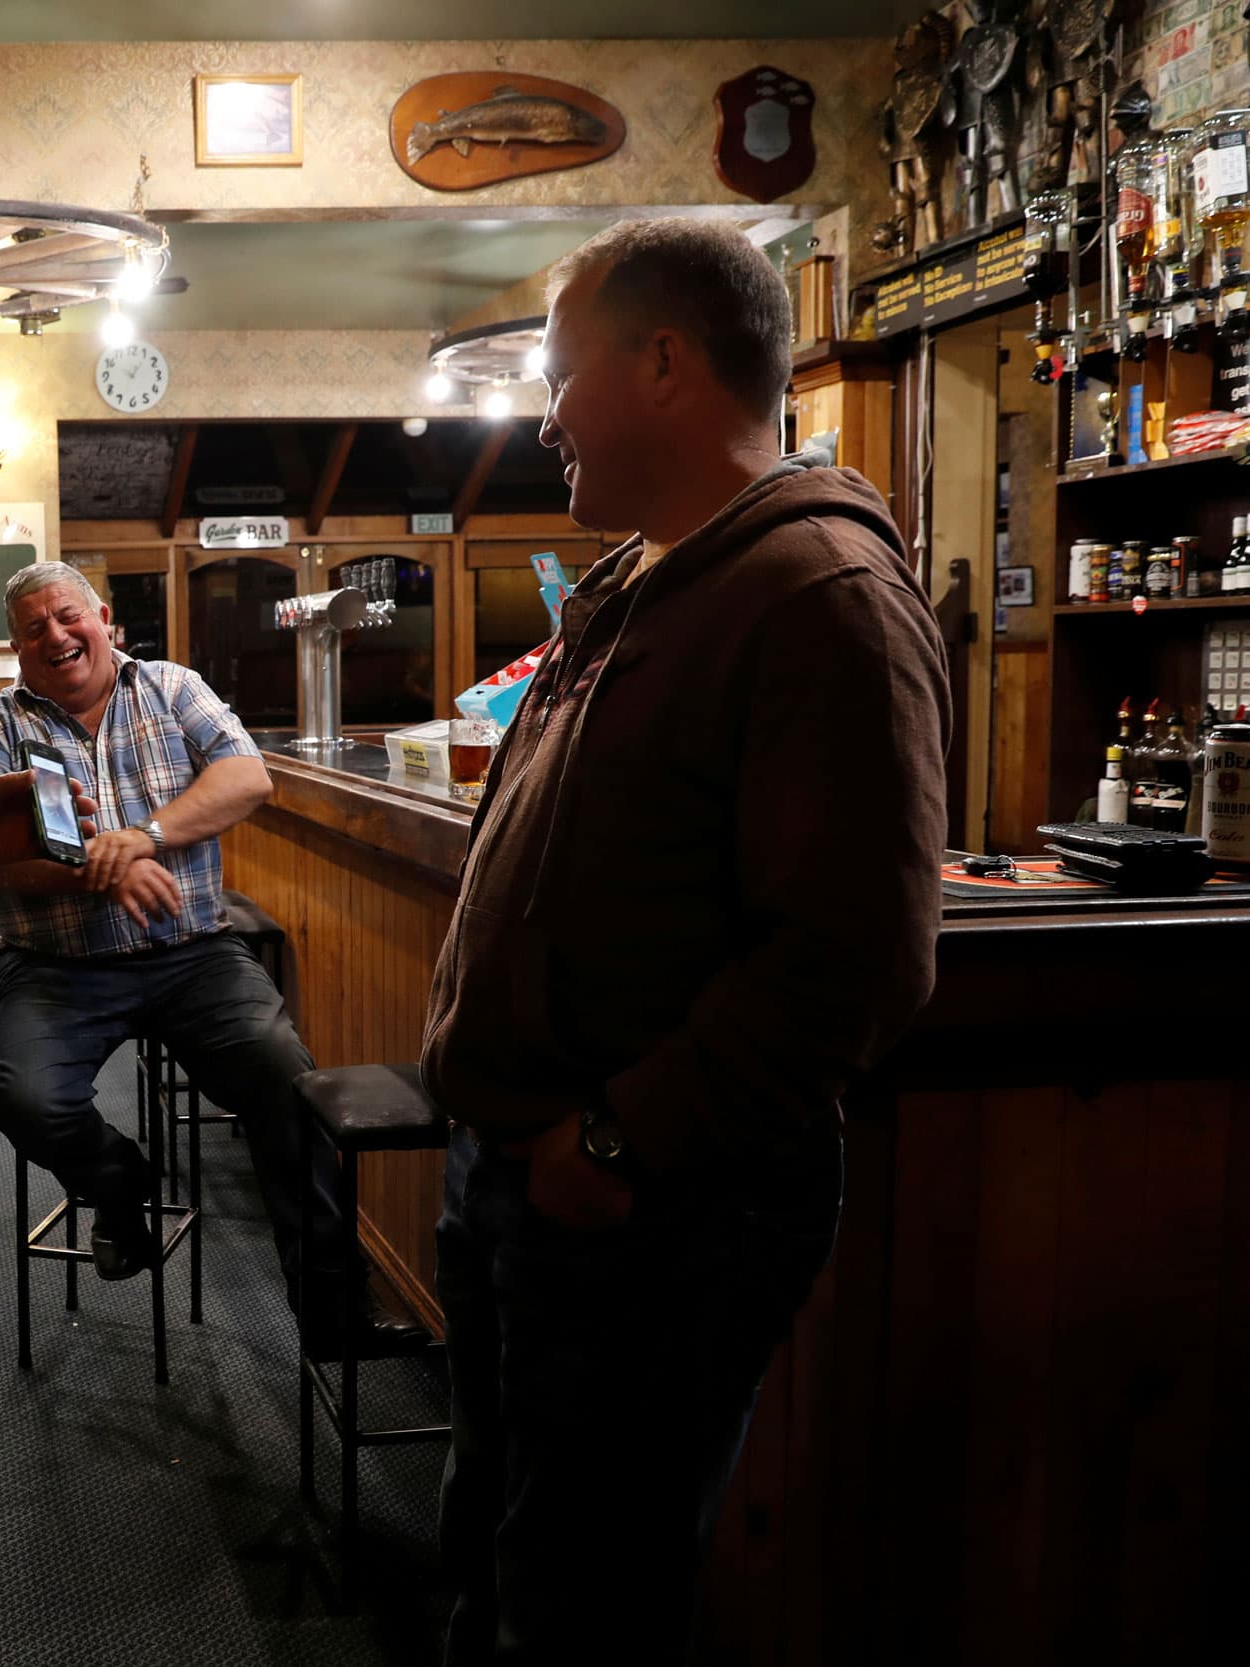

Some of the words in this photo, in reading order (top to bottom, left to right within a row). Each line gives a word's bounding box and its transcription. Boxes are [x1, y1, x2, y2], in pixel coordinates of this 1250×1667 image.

[142, 348, 147, 359] 1
[150, 356, 158, 368] 2
[102, 371, 110, 383] 9
[156, 370, 162, 381] 3
[1220, 364, 1250, 380] trans
[107, 384, 114, 395] 8
[152, 384, 159, 394] 4
[116, 394, 123, 405] 7
[129, 396, 137, 407] 6
[142, 393, 150, 404] 5
[2, 515, 34, 538] Ams
[417, 515, 449, 533] EXIT
[205, 523, 242, 543] Garden
[247, 523, 282, 540] BAR
[1204, 755, 1222, 777] JIM
[1224, 751, 1250, 770] BEA
